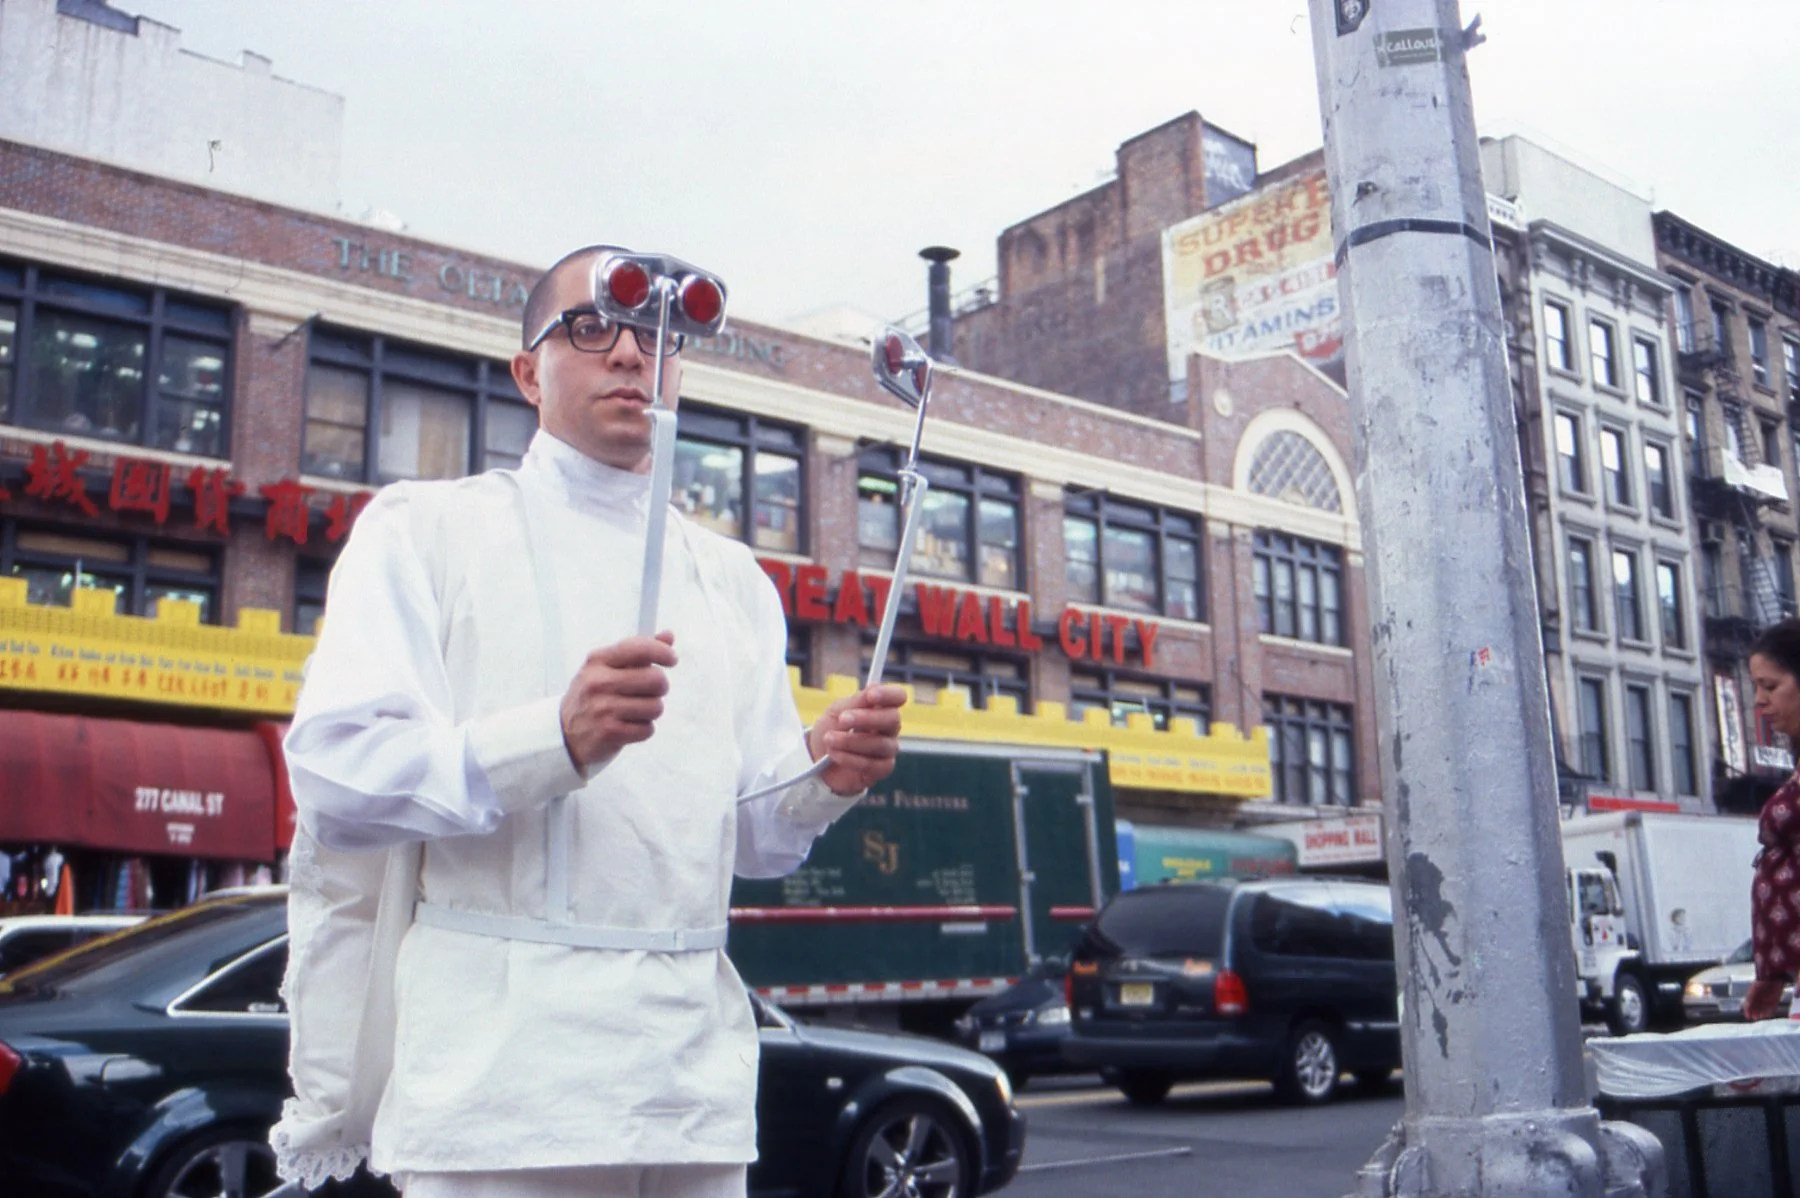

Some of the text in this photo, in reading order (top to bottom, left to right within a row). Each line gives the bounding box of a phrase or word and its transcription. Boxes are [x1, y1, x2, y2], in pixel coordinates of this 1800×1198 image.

[332, 236, 414, 284] THE
[1204, 212, 1320, 278] DRUG
[757, 557, 1158, 669] REAT WALL CITY
[135, 786, 225, 817] 277 CANAL ST
